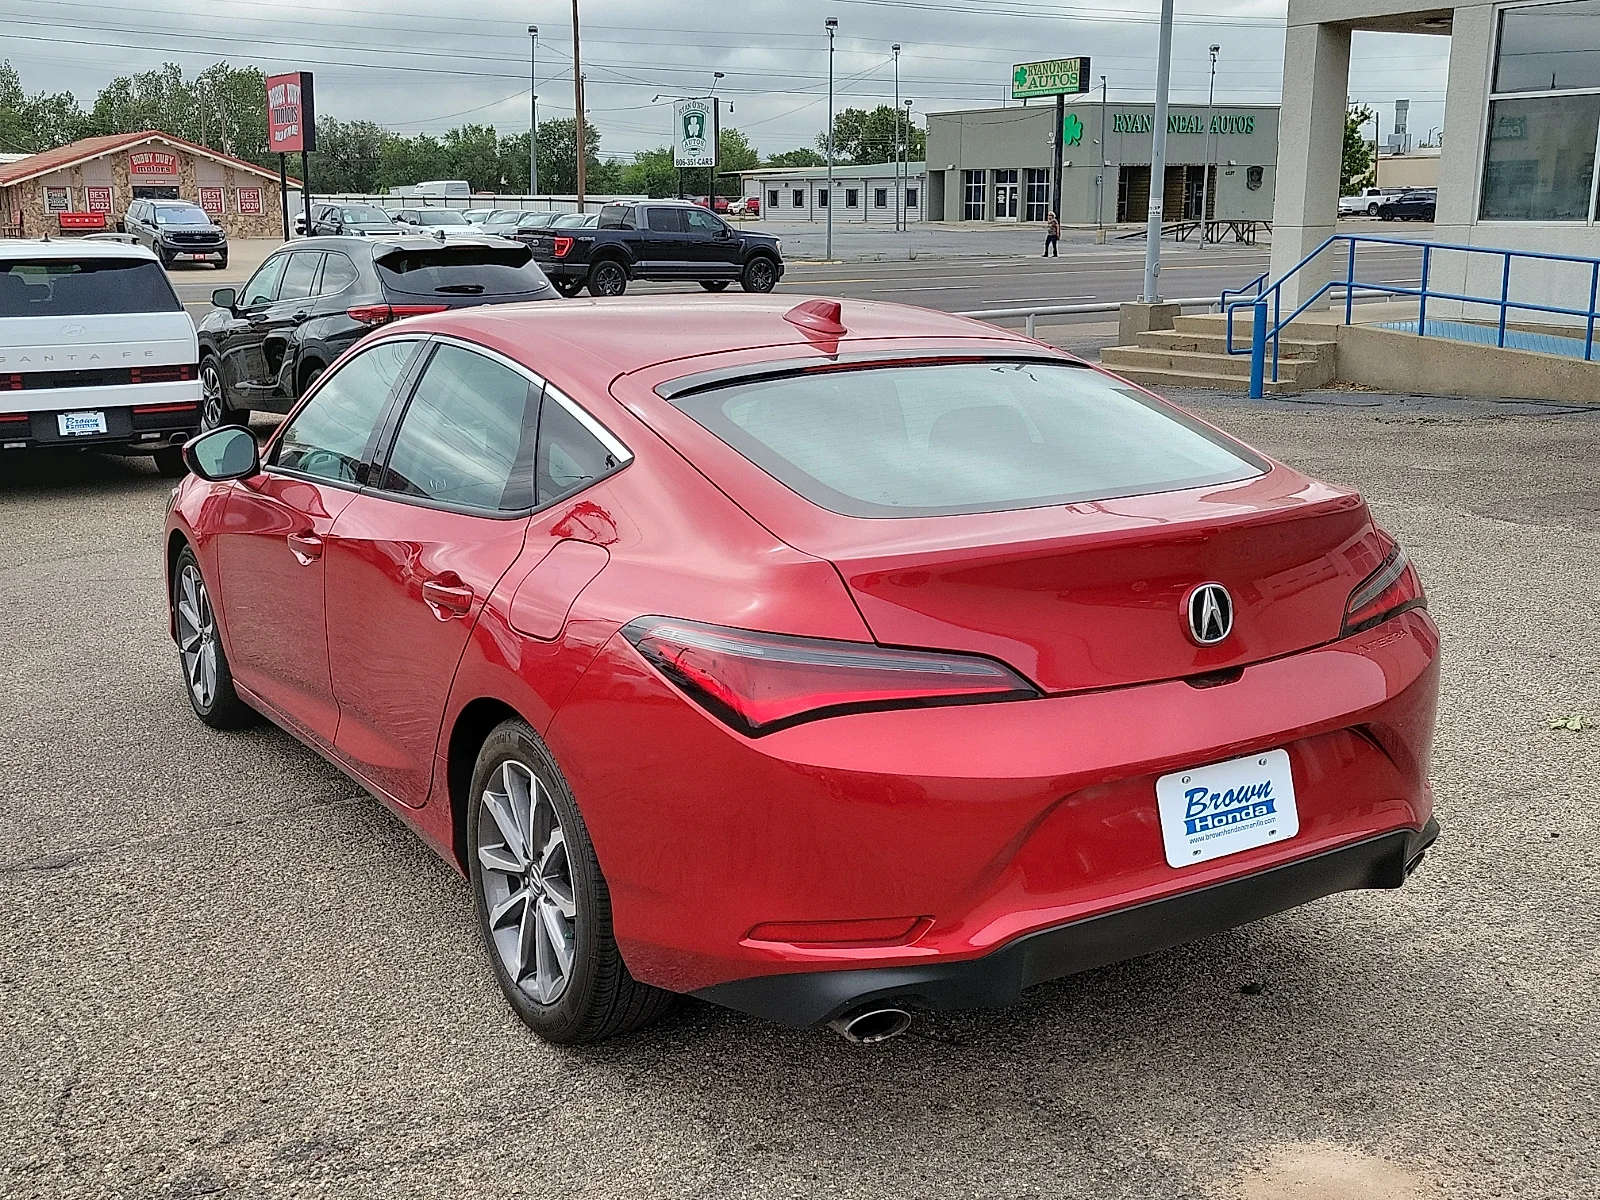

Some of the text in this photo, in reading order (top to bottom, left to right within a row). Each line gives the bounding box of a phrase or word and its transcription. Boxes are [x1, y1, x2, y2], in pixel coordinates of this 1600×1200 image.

[1028, 63, 1048, 76] RYAN
[1027, 72, 1078, 89] AUTOS
[1113, 113, 1153, 133] RYAN
[1210, 115, 1255, 134] AUTOS
[684, 139, 705, 147] AUTOS
[131, 153, 175, 166] BOBBY DUBY
[676, 158, 713, 166] 806-351-CARS
[136, 165, 172, 173] motors
[89, 191, 109, 199] BEST
[202, 191, 221, 199] BEST
[240, 191, 258, 199] BEST
[91, 202, 110, 210] 2022
[203, 202, 221, 210] 2021
[242, 202, 260, 210] 2020
[122, 350, 154, 358] FE
[1184, 779, 1273, 819] Brown
[1194, 803, 1268, 832] Honda
[1189, 816, 1277, 845] www.brownhondaamarillo.com
